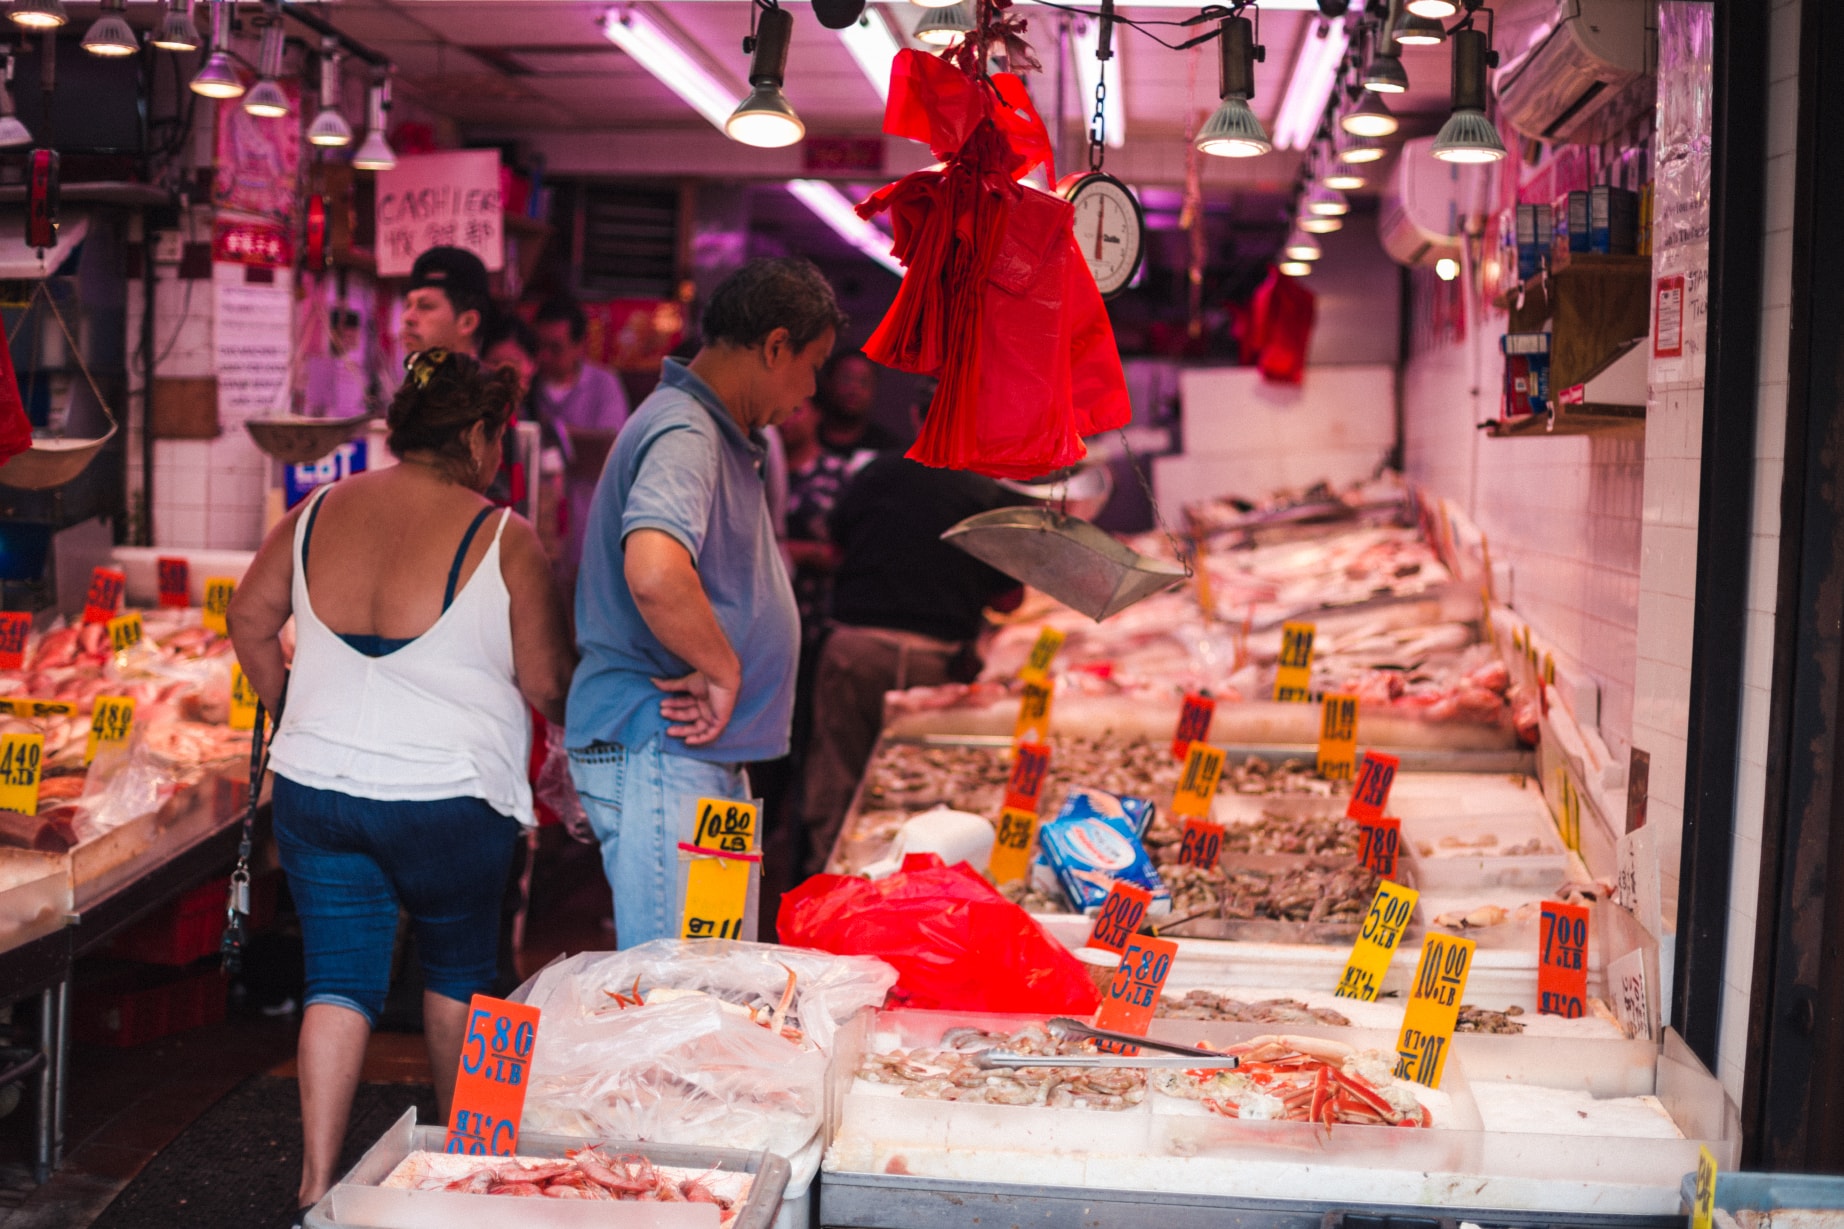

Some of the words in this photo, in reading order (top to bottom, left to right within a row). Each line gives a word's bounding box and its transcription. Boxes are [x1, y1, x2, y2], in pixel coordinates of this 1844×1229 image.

[720, 837, 746, 851] LB
[1377, 929, 1396, 949] LB
[1563, 955, 1583, 970] LB
[1132, 986, 1155, 1007] LB
[1437, 985, 1456, 1007] LB
[495, 1060, 523, 1086] LB
